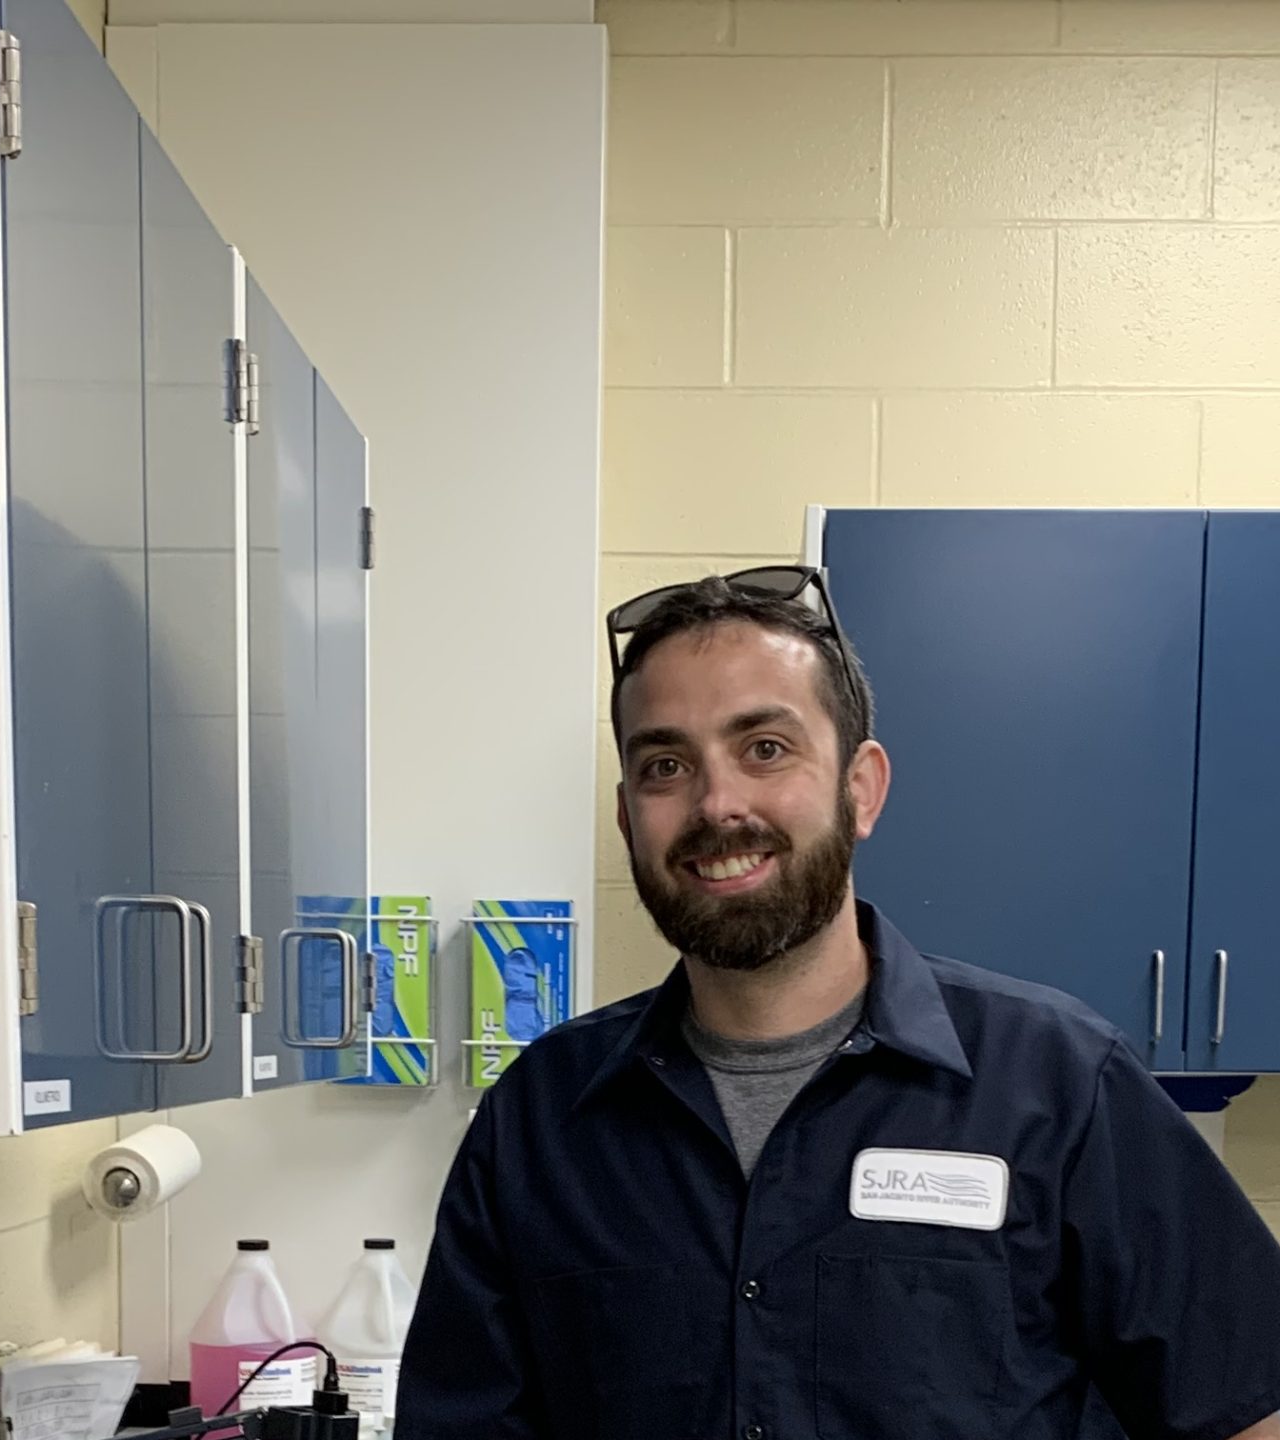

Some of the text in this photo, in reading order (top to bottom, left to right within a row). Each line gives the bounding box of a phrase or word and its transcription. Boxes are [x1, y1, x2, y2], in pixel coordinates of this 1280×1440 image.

[397, 905, 418, 978] NPF
[481, 1008, 502, 1080] NPF
[861, 1169, 928, 1192] SJRA
